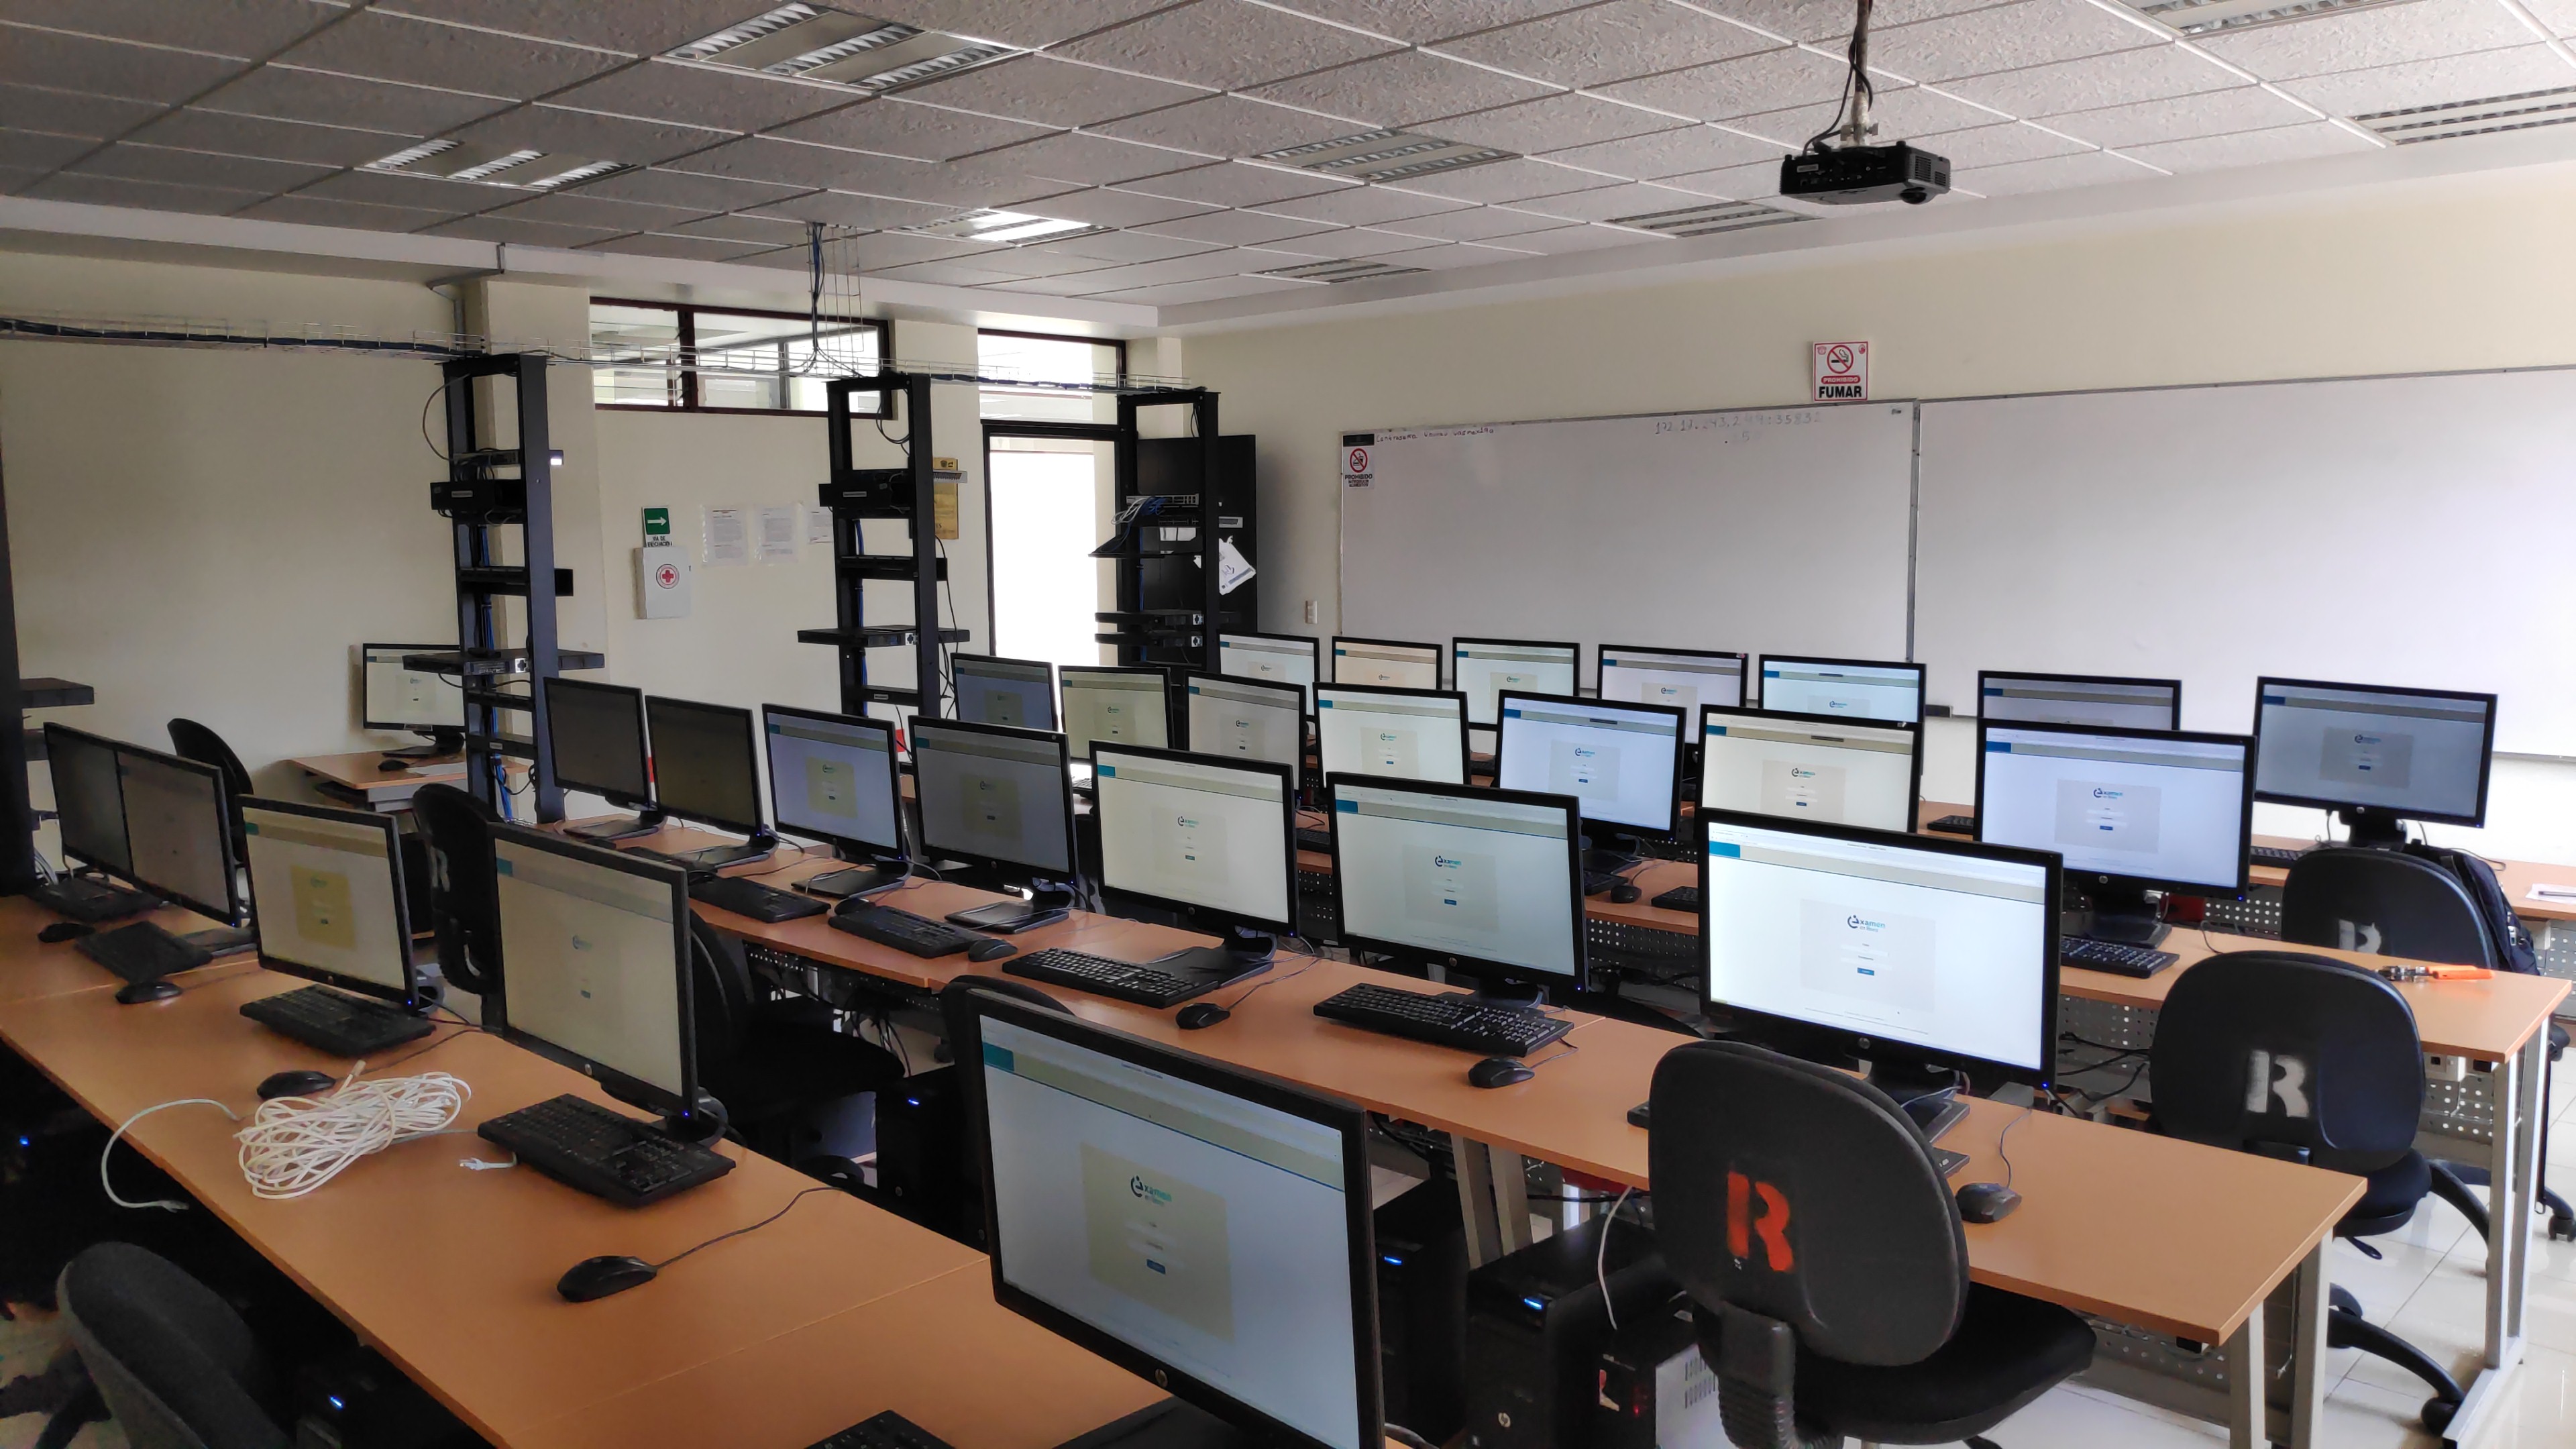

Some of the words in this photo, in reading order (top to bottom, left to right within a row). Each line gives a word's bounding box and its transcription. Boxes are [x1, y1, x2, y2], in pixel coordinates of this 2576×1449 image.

[1819, 386, 1862, 398] FUMAR
[2246, 1050, 2310, 1118] R
[1727, 1169, 1794, 1272] R
